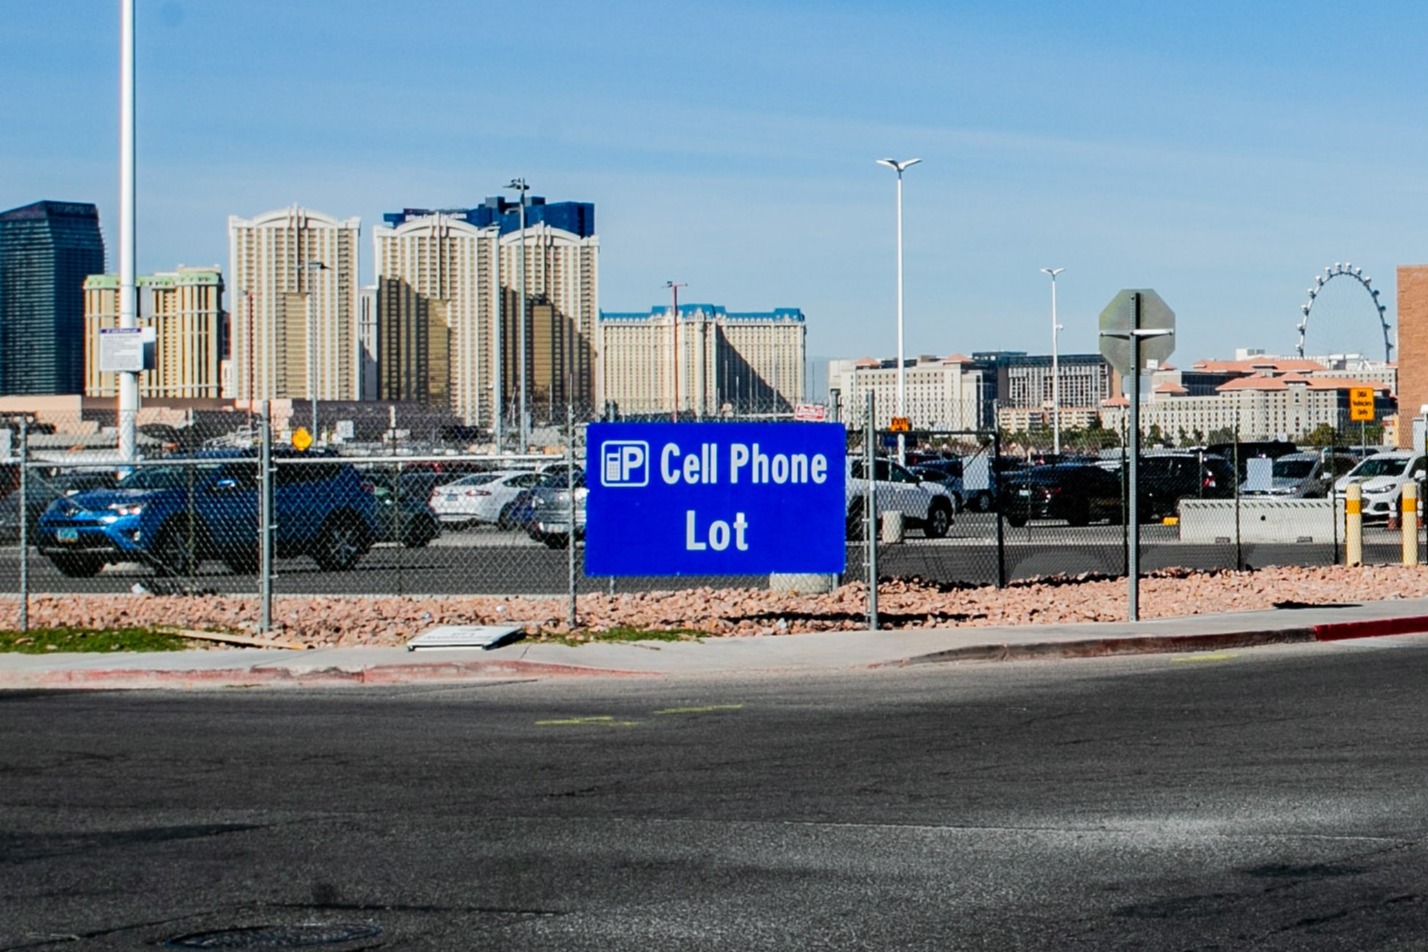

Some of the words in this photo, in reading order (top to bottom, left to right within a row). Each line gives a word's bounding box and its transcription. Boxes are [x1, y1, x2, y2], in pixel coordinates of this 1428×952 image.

[660, 442, 718, 484] Cell
[730, 442, 828, 484] Phone
[686, 510, 749, 551] Lot
